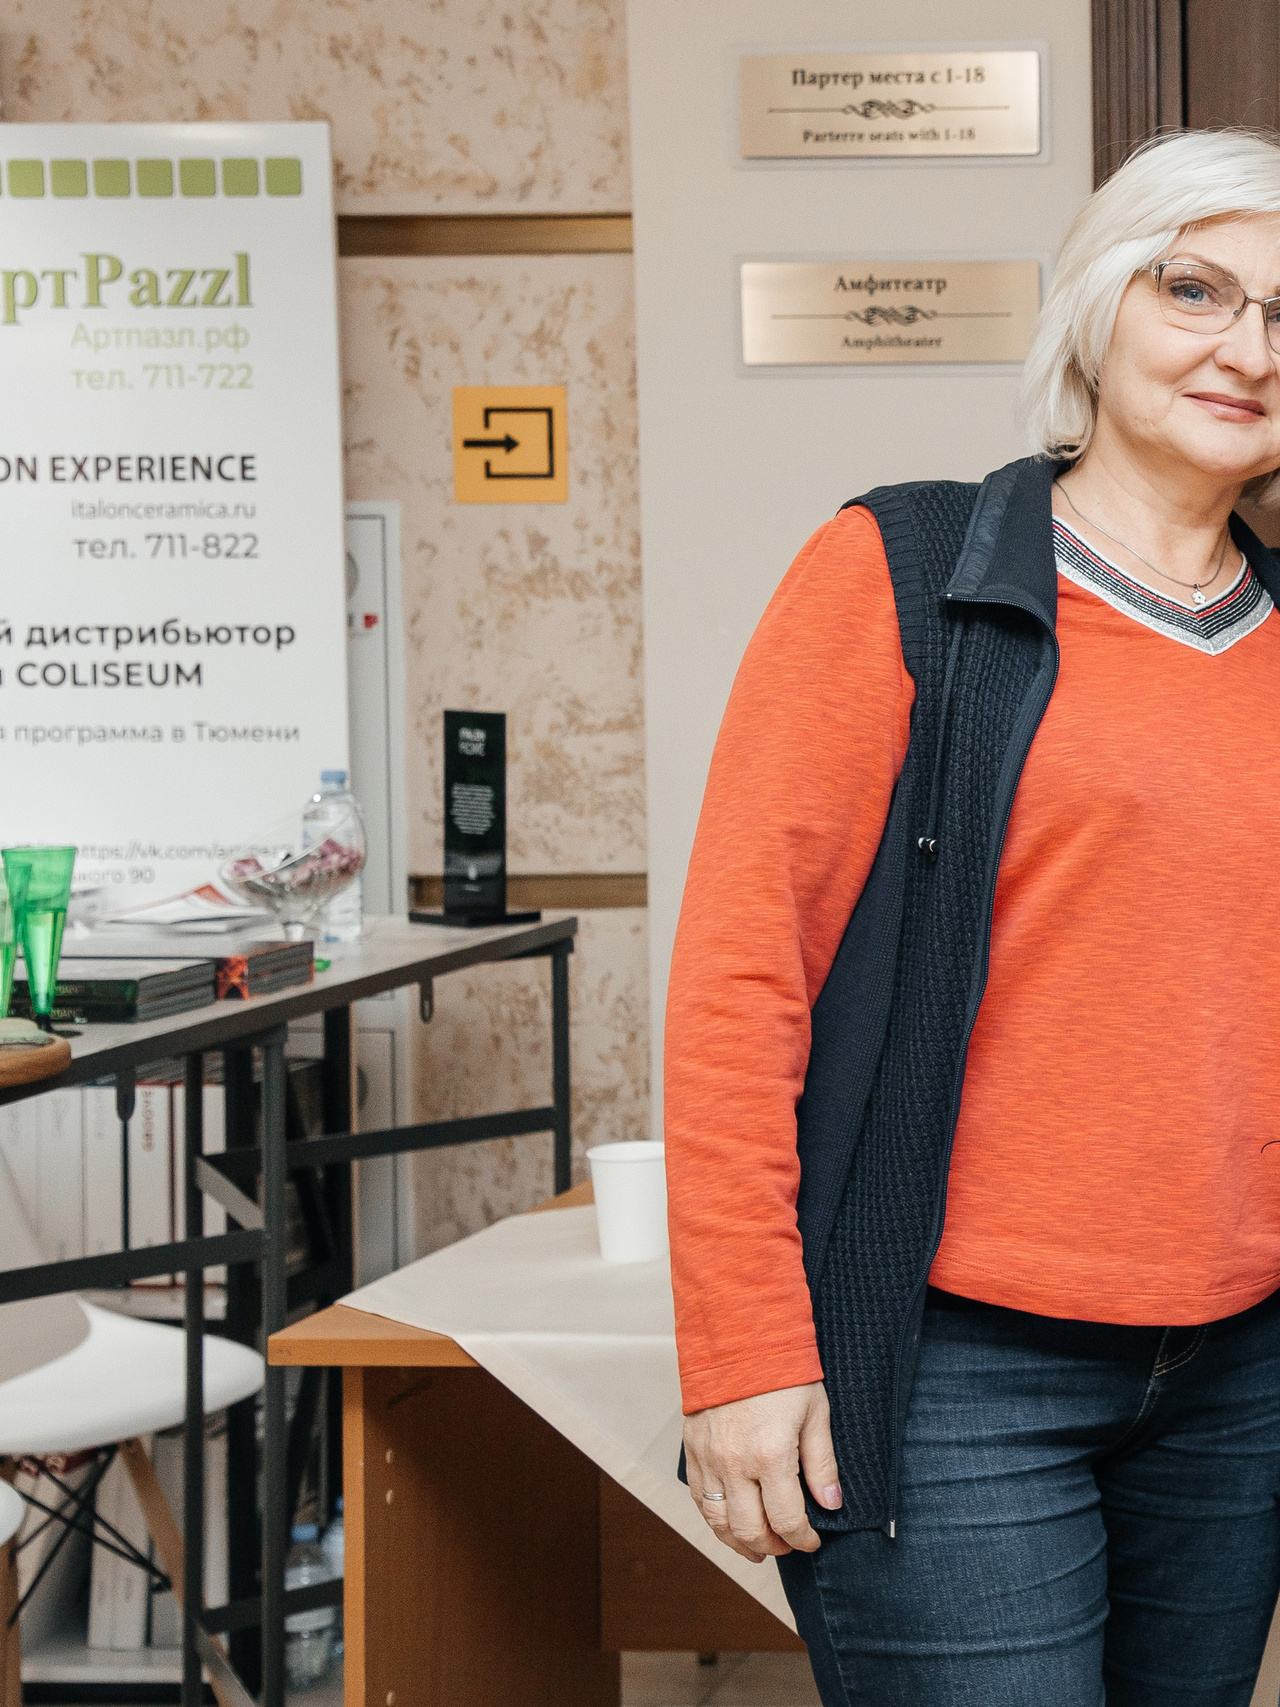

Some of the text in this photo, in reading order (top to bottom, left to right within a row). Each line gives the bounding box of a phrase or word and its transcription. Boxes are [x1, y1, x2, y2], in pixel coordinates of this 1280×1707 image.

[792, 67, 986, 90] Партер места с 1-18
[834, 274, 948, 296] Амфитеатр
[71, 363, 255, 390] тел. 711-722
[51, 455, 257, 482] EXPERIENCE
[70, 497, 257, 520] italonceramica.ru
[72, 532, 259, 560] тел. 711-822
[26, 618, 296, 651] дистрибьютор
[17, 662, 203, 687] COLISEUM
[14, 719, 301, 746] программа в Тюмени
